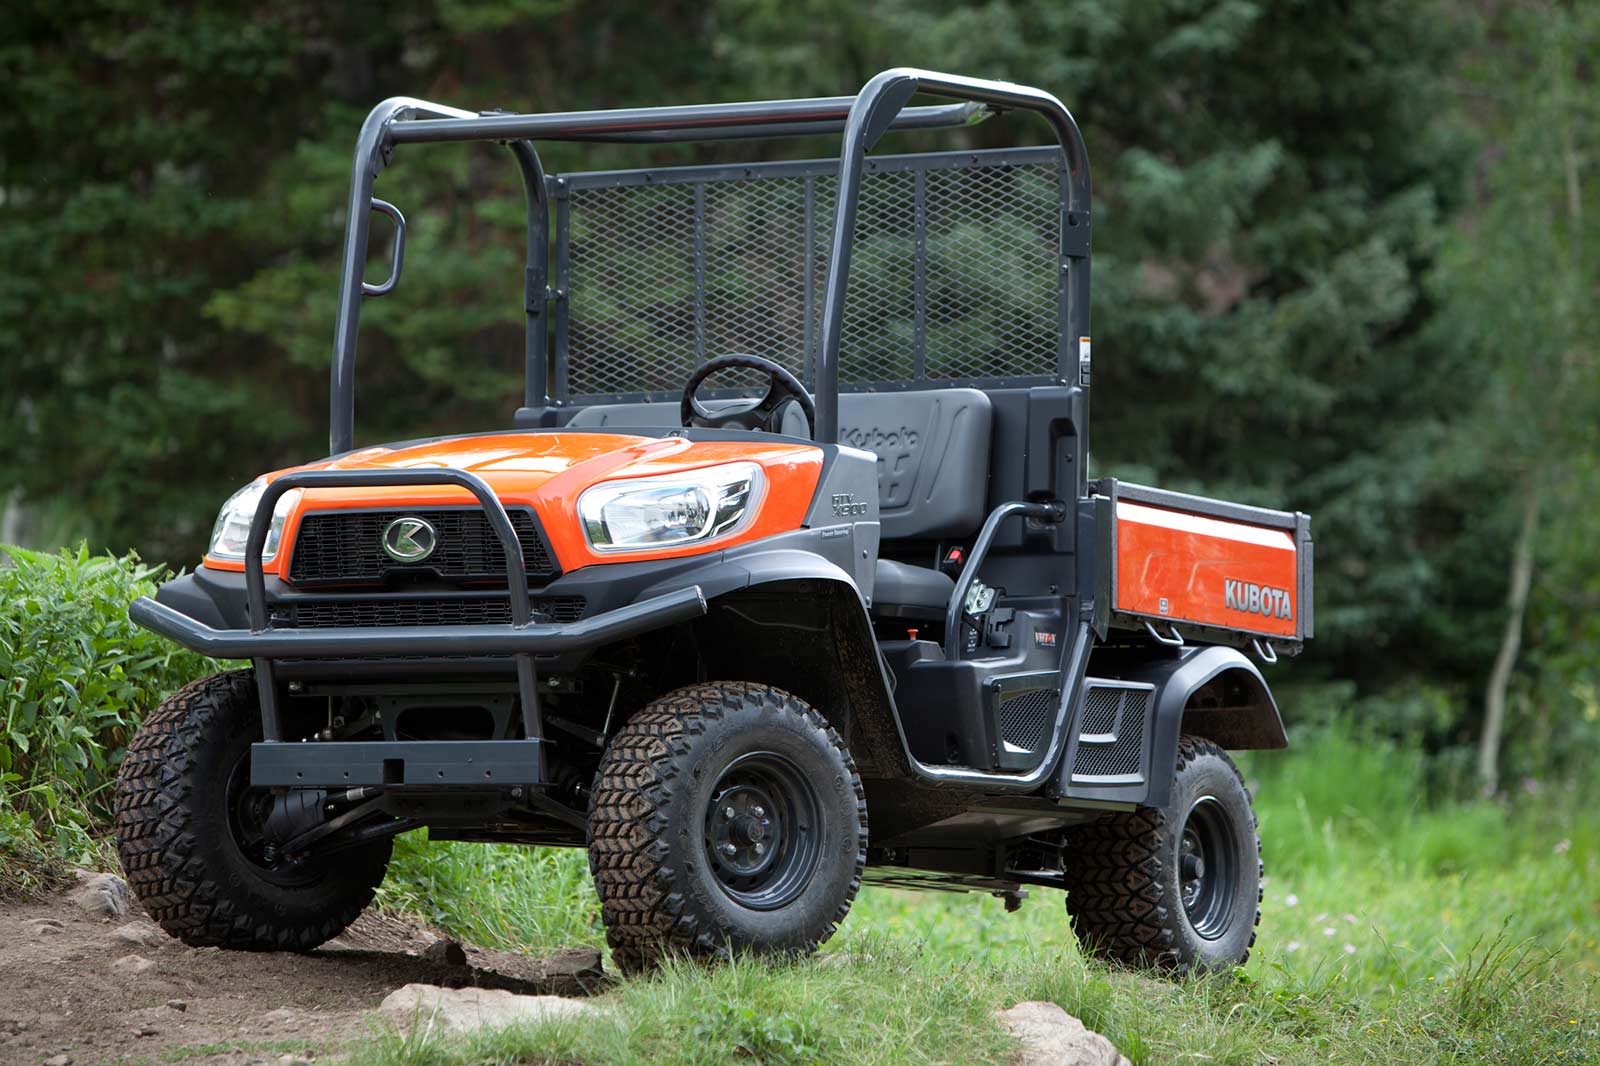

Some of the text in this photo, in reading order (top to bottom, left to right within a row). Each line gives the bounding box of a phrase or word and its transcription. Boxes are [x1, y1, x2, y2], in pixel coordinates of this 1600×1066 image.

[840, 426, 919, 449] Kubota
[832, 503, 867, 518] X900
[1225, 577, 1292, 621] KUBOTA
